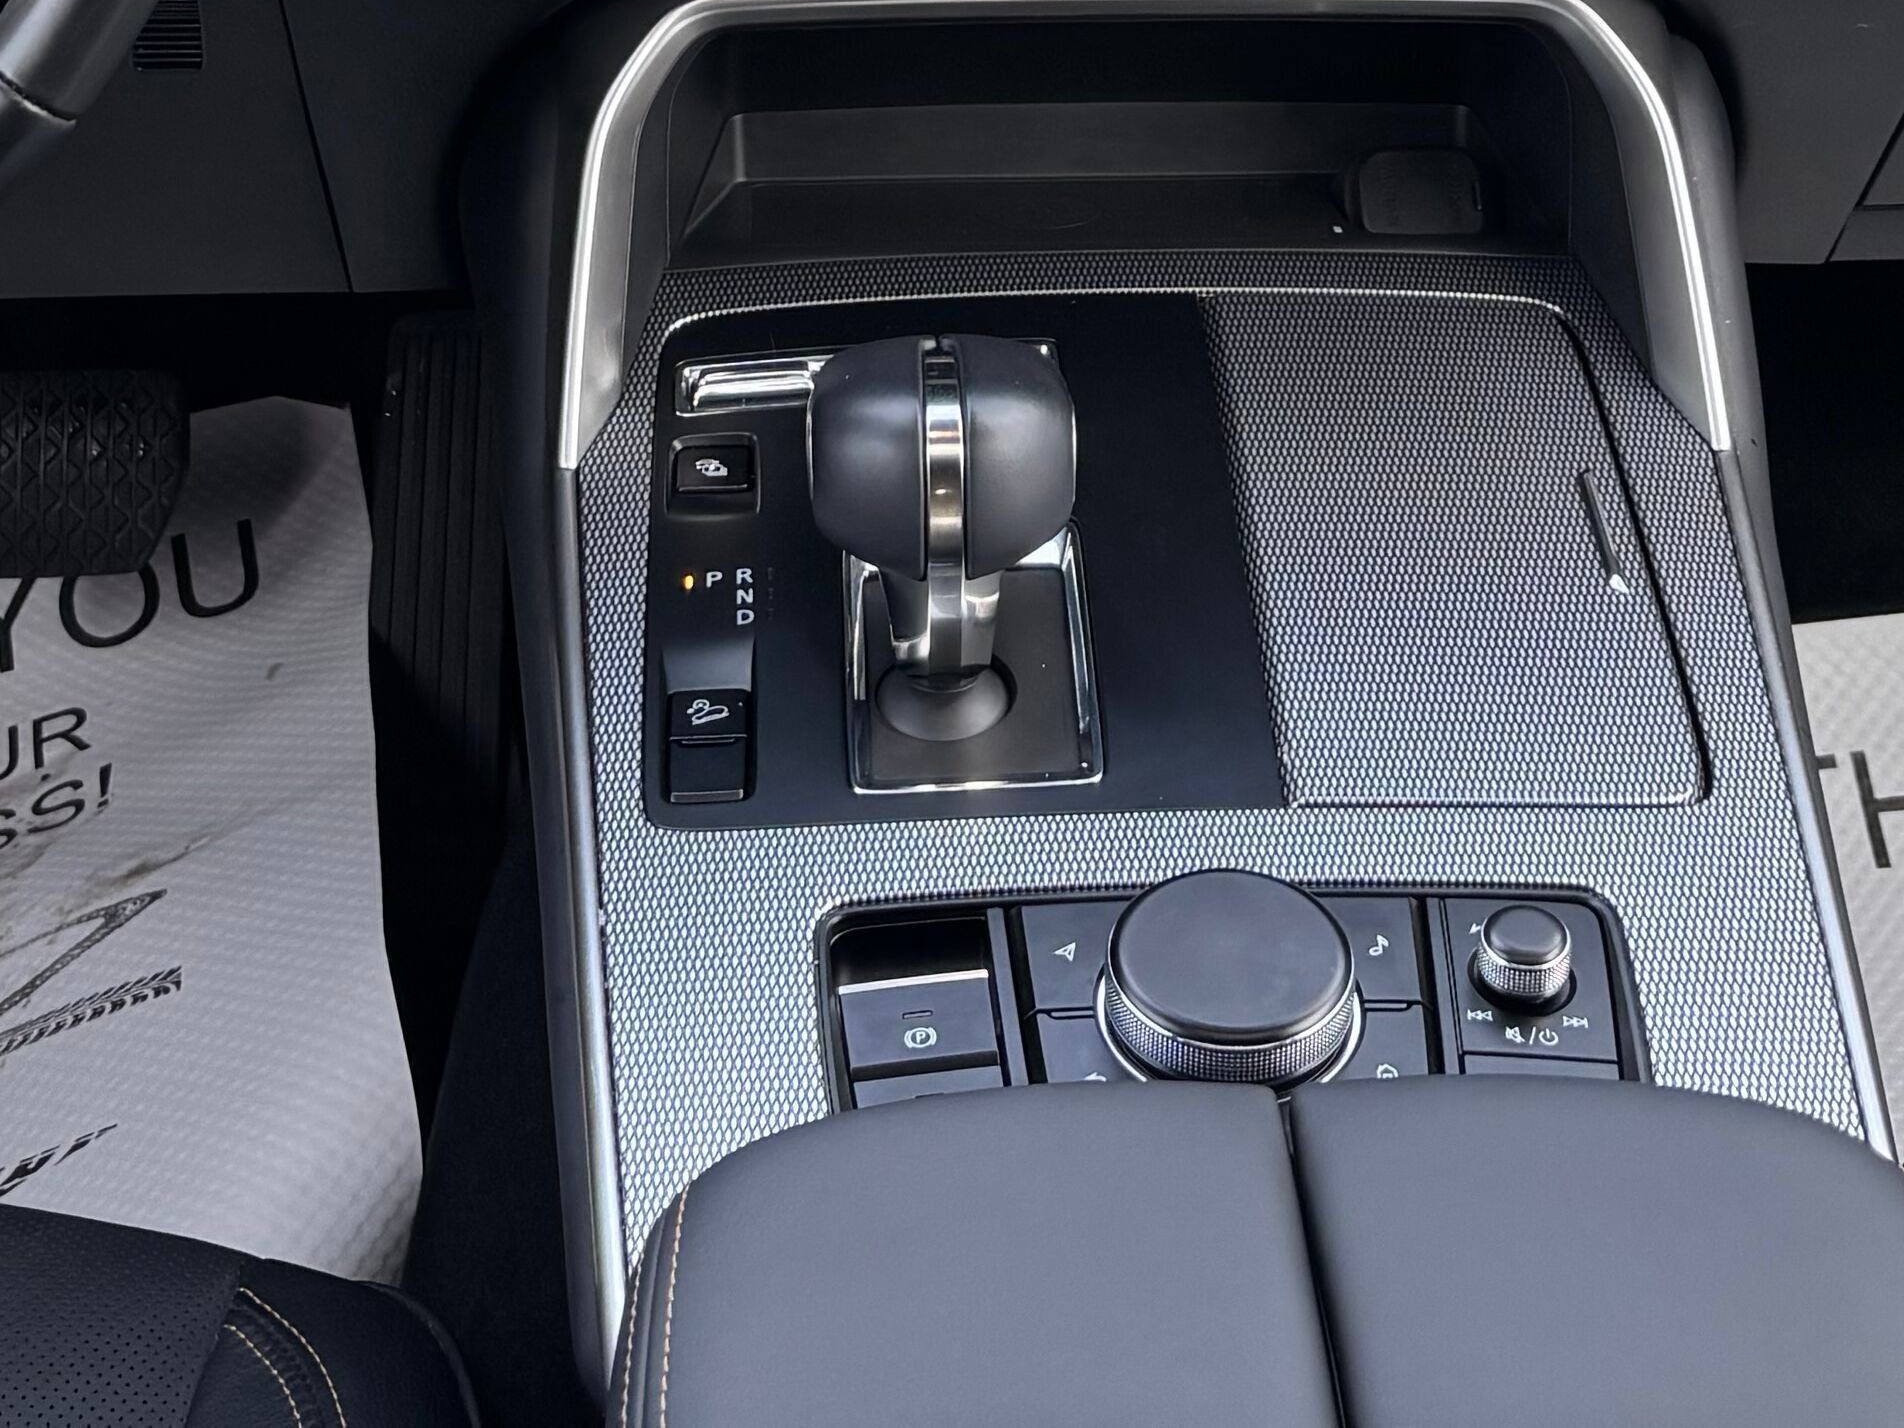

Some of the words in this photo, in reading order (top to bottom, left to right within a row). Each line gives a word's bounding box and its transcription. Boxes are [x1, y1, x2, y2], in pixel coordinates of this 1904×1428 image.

[705, 571, 723, 588] P
[736, 568, 754, 585] R
[736, 587, 754, 605] N
[736, 608, 755, 626] D
